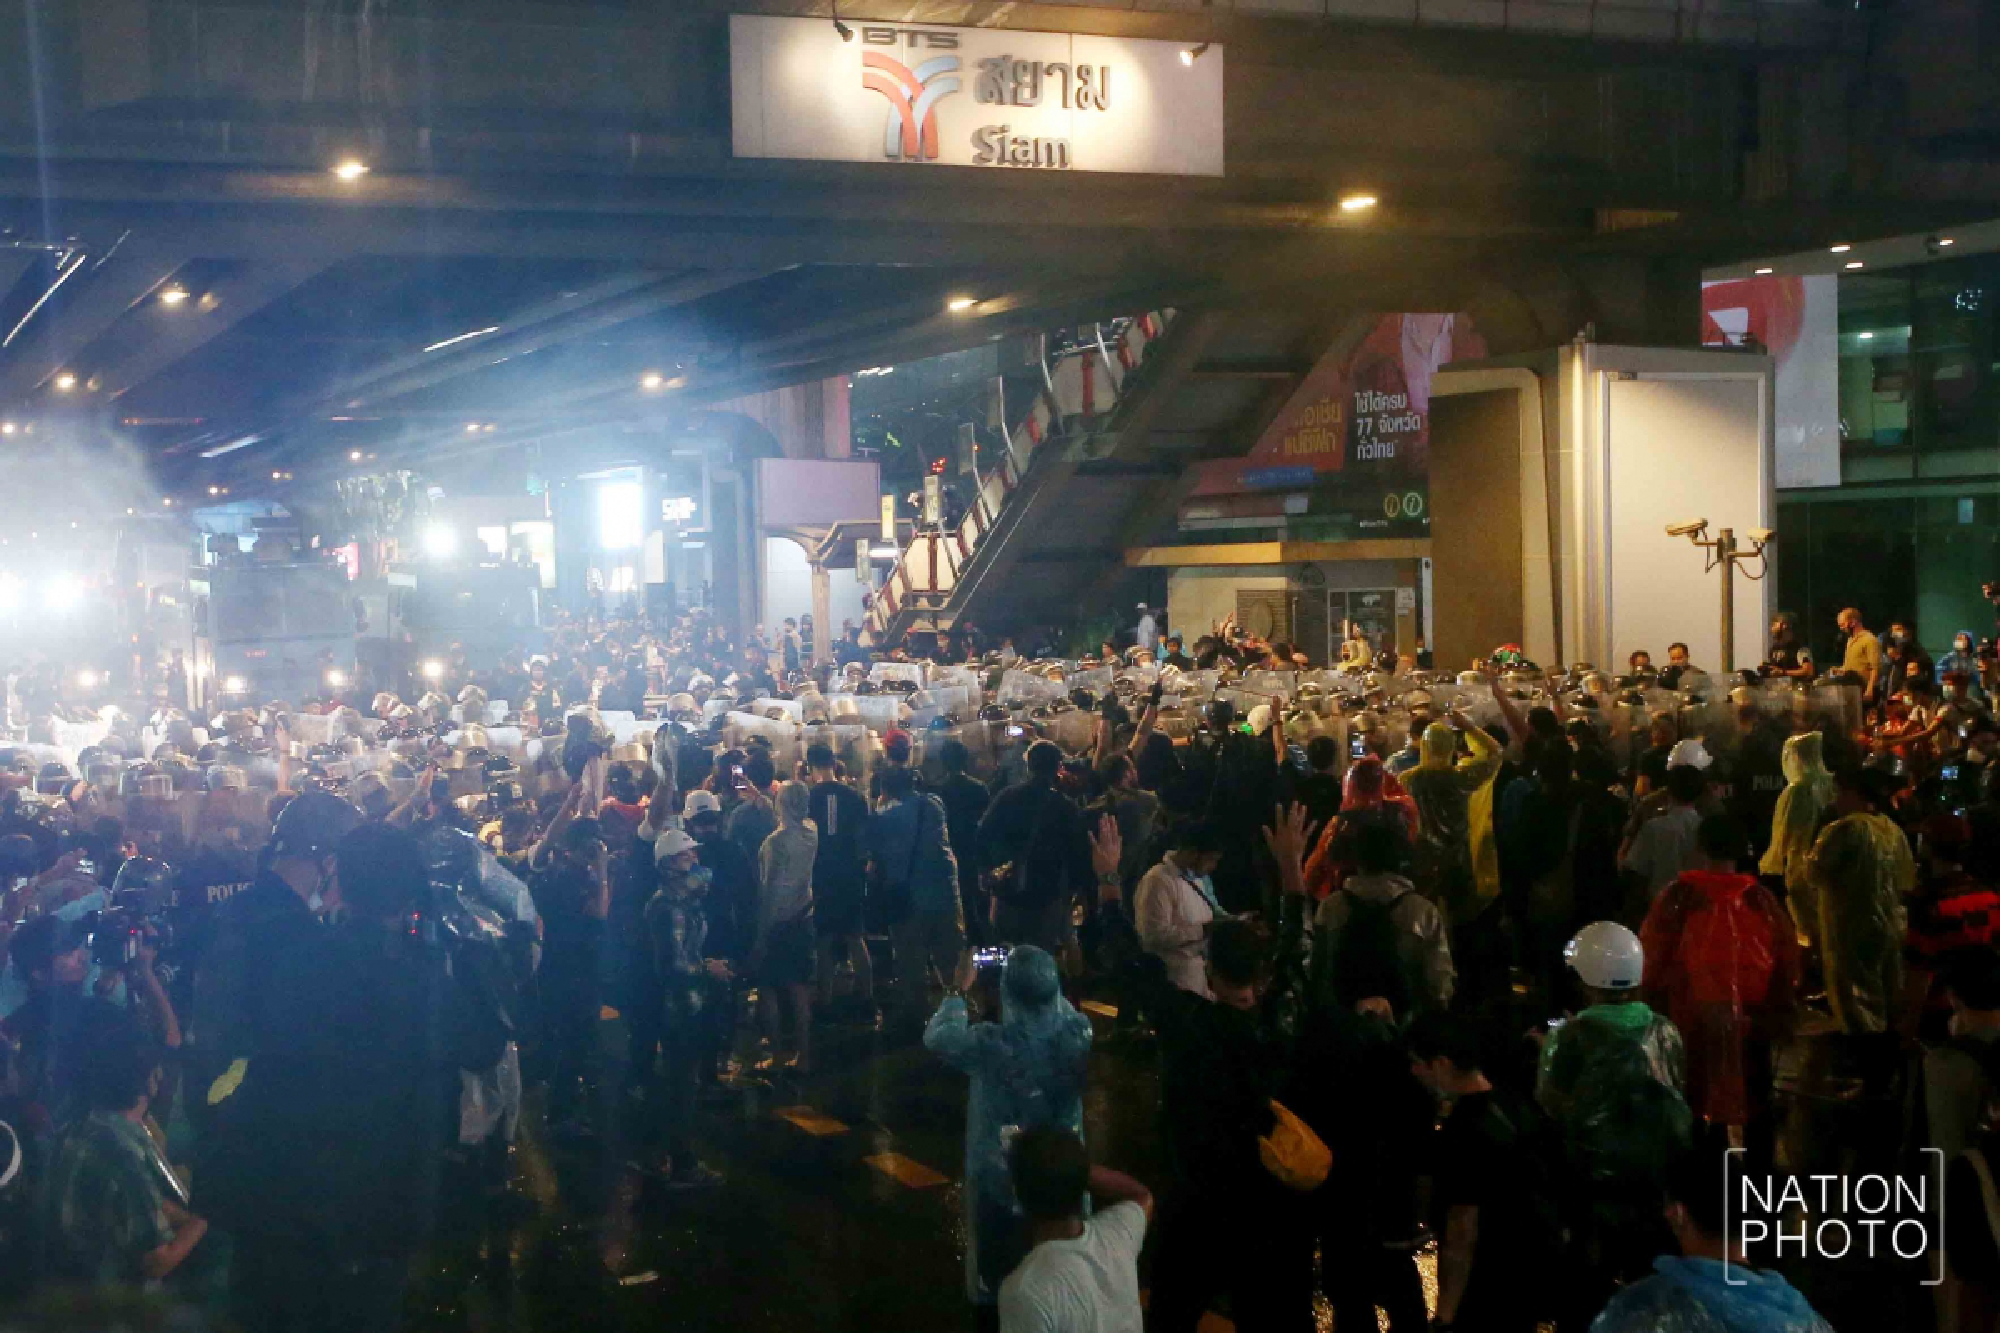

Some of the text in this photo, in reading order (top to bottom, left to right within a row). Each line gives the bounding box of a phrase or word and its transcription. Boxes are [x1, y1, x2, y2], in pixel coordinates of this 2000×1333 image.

[862, 27, 961, 49] BTS
[974, 54, 1110, 111] สยาม
[970, 124, 1070, 168] Siam
[1354, 390, 1407, 413] ใช้ได้ครบ
[1357, 410, 1421, 436] 77 จังหวัด
[1357, 435, 1394, 460] ทั่วไทย
